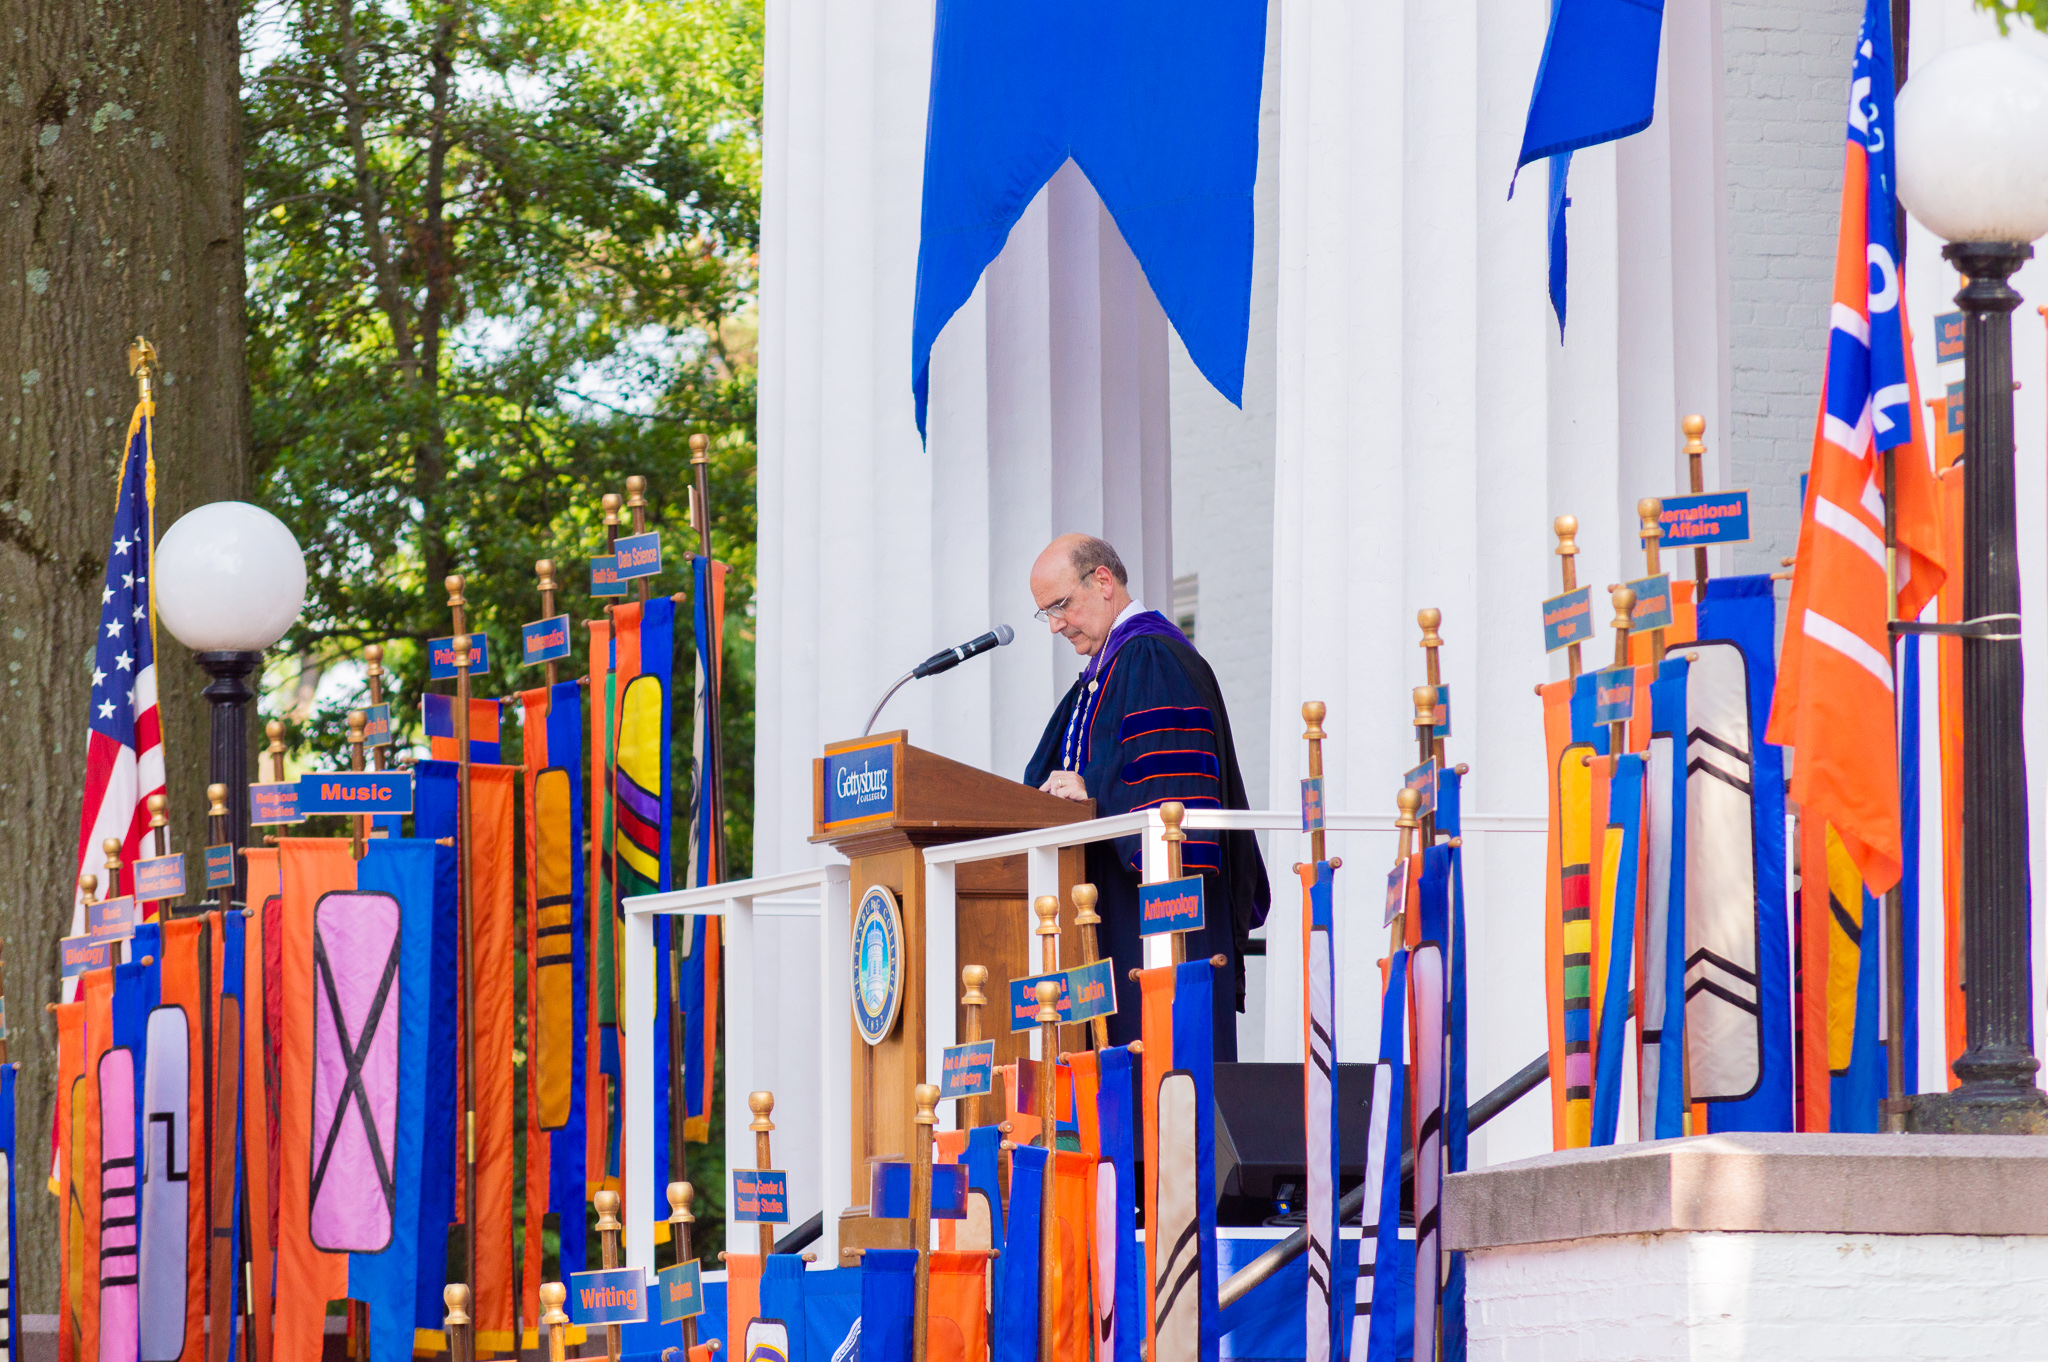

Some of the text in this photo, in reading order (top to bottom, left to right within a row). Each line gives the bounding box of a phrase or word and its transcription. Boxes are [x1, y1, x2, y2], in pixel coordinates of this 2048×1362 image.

[1660, 500, 1742, 523] ternational
[1668, 520, 1720, 539] Affairs
[617, 546, 657, 569] Data Science
[526, 628, 565, 654] Mathematics
[434, 646, 482, 666] Philohy
[321, 783, 392, 801] Music
[837, 760, 888, 805] Gettysburg
[255, 792, 299, 806] Religious
[860, 790, 881, 804] COLLEGE
[260, 806, 295, 819] Studies
[1144, 893, 1199, 922] Anthropology
[65, 946, 105, 966] Biology
[1061, 978, 1068, 992] &
[1077, 979, 1106, 1004] Latin
[944, 1052, 992, 1070] Art & Art History
[950, 1071, 982, 1088] Art History
[757, 1179, 778, 1195] Gender
[778, 1180, 784, 1195] &
[737, 1196, 783, 1216] Sexuality Studies
[580, 1286, 637, 1311] Writing
[669, 1279, 693, 1303] Business
